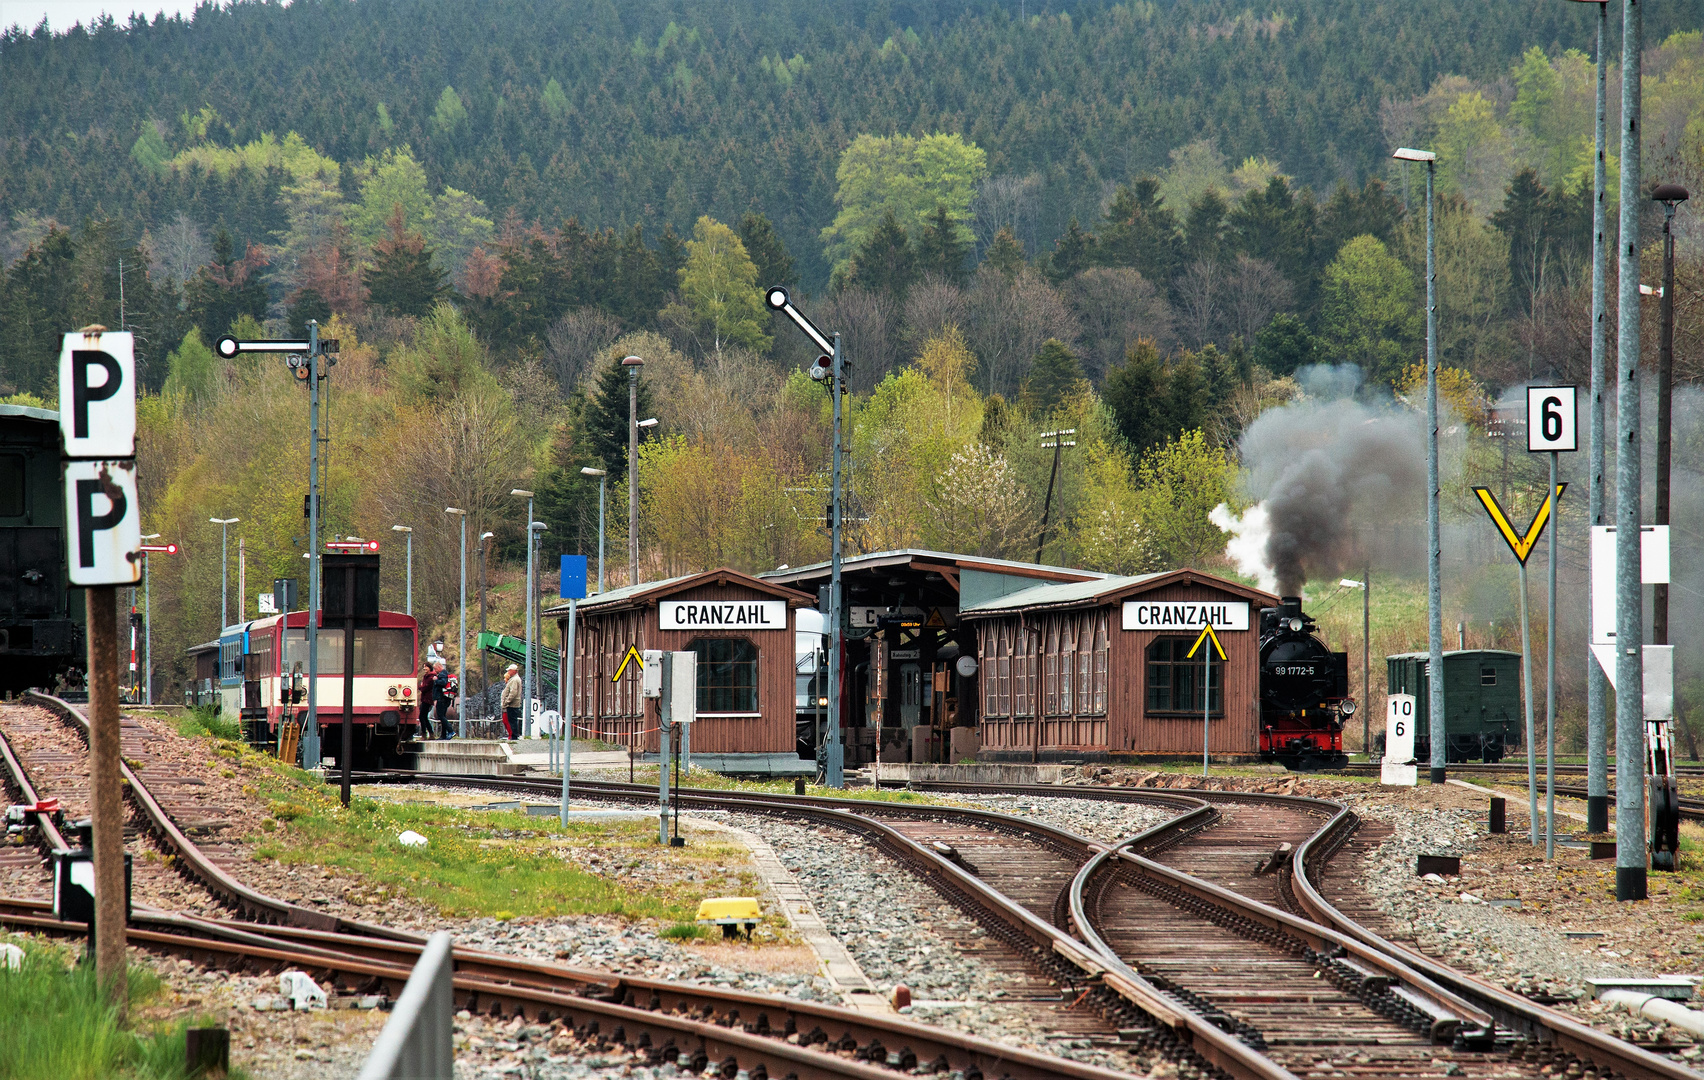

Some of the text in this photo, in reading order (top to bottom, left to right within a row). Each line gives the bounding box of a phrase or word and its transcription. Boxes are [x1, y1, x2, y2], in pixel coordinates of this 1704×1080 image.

[72, 350, 123, 439] P
[1541, 396, 1563, 442] 6
[76, 479, 128, 568] P
[674, 605, 771, 625] CRANZAHL
[1138, 605, 1233, 625] CRANZAHL
[1275, 667, 1314, 675] 99 1772-5
[1392, 700, 1412, 716] 10
[1395, 721, 1405, 737] 6
